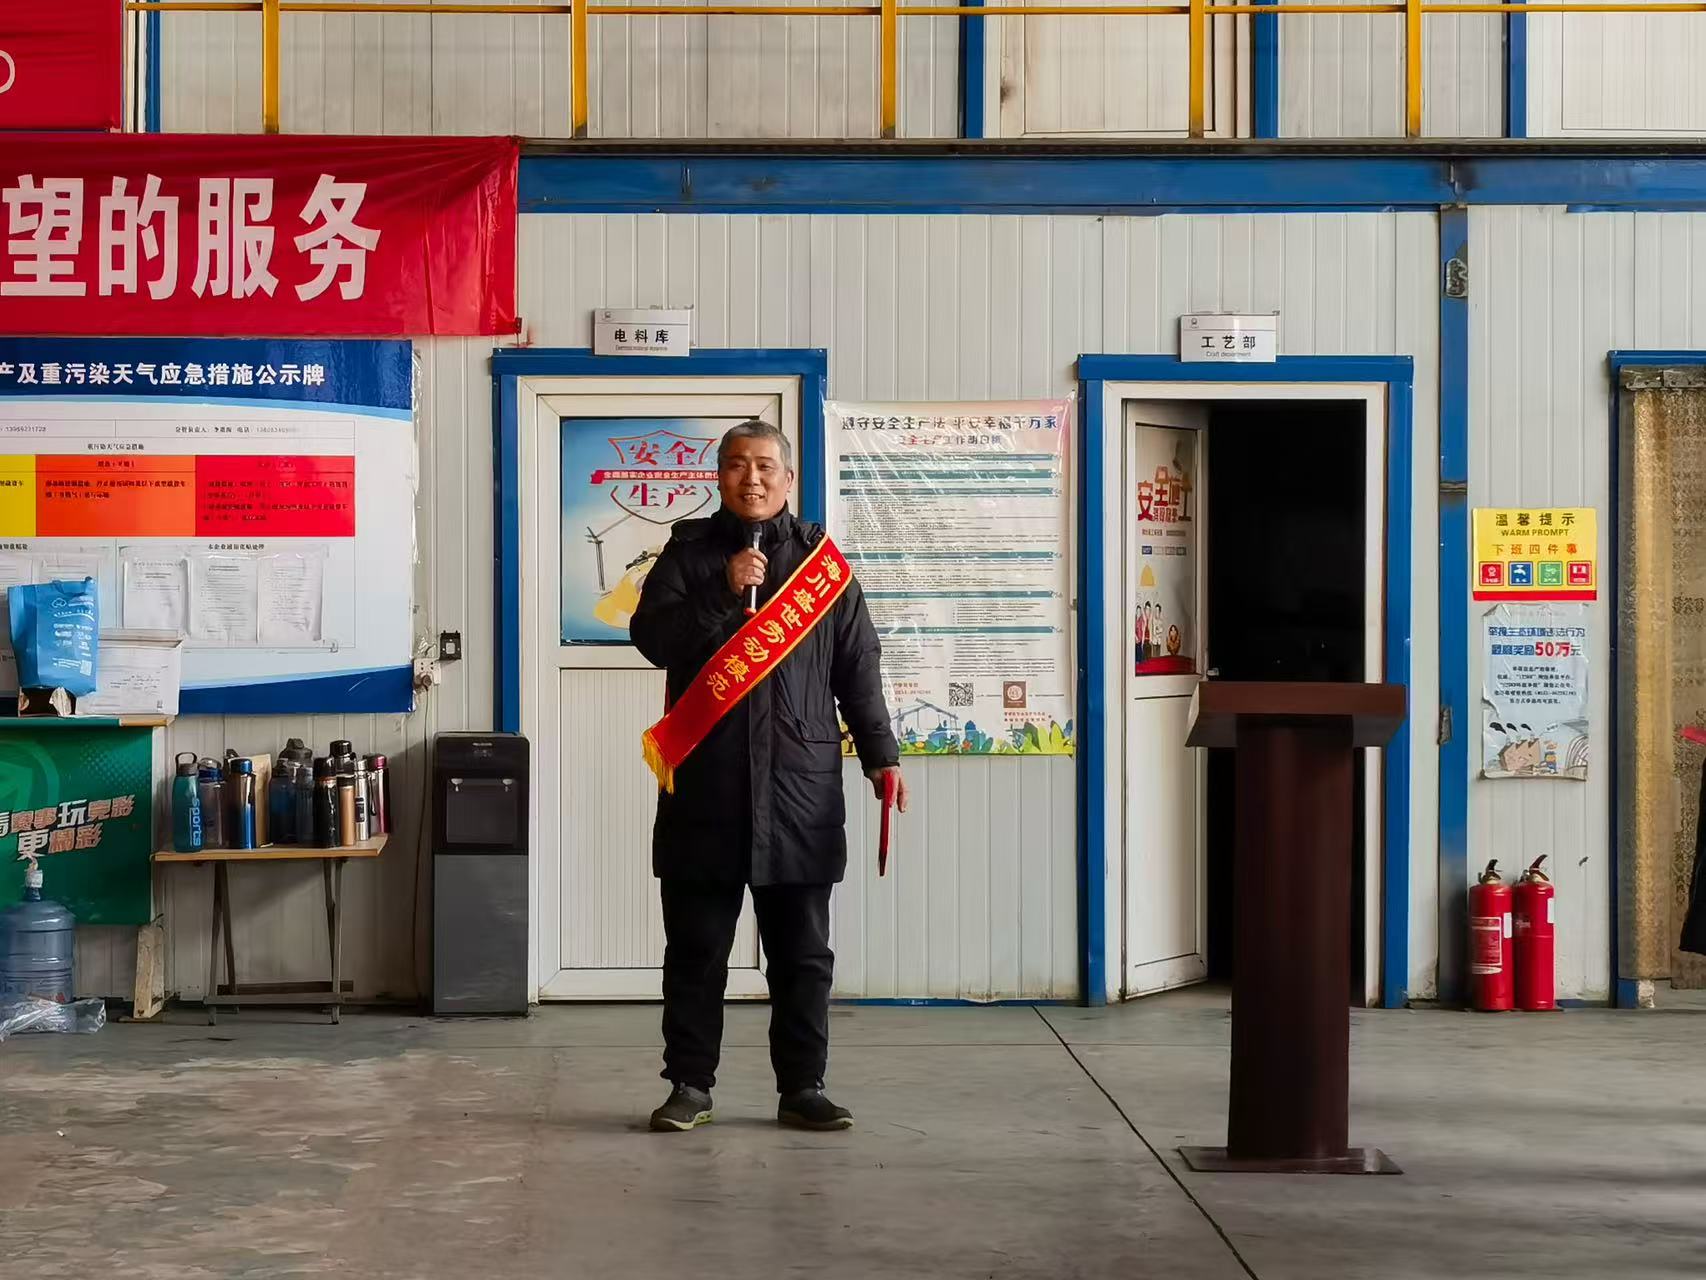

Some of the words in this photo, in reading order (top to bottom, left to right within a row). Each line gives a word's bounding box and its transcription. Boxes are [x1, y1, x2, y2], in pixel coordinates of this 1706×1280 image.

[2, 173, 381, 301] 望的服务
[614, 329, 669, 343] 电料库
[1201, 336, 1256, 349] 工艺部
[628, 440, 698, 466] 安全
[627, 482, 698, 508] 生产
[1495, 513, 1575, 526] 温馨提示
[1501, 529, 1530, 537] WARM
[1532, 529, 1569, 537] PROMPT
[1492, 543, 1578, 555] 下班四件事
[706, 554, 842, 702] 海川盛世劳动模范
[191, 797, 202, 847] sports
